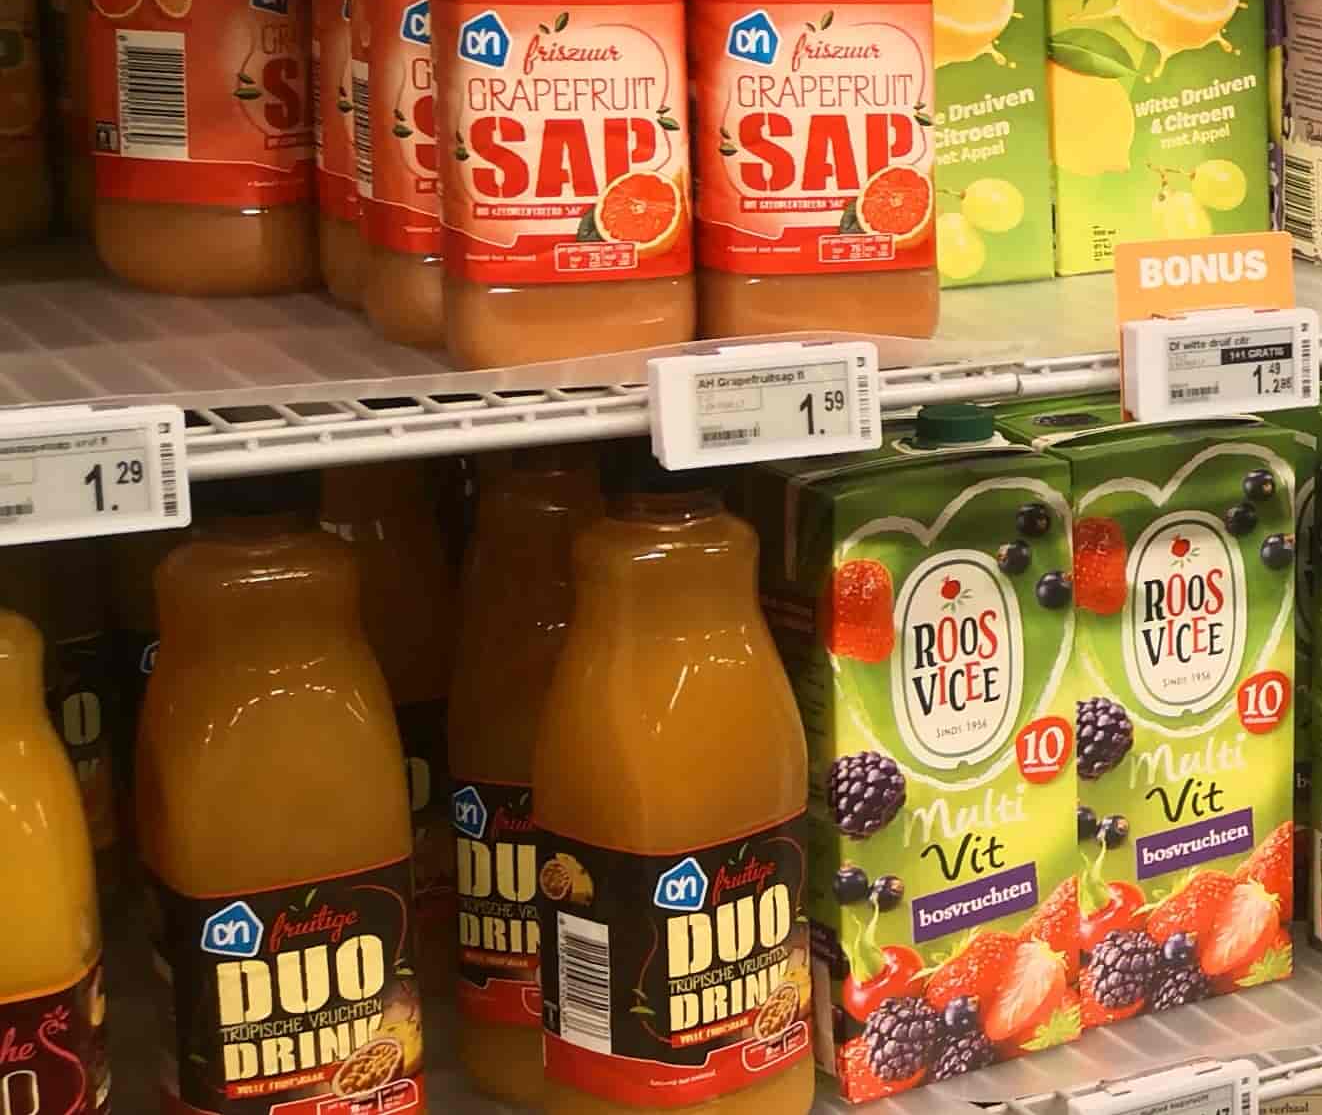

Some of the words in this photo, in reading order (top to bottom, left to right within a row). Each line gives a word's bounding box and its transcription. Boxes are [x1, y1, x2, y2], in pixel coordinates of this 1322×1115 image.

[523, 33, 626, 75] friszuur
[792, 32, 882, 72] friszuur
[468, 77, 656, 113] GRAPEFRUIT
[737, 74, 914, 110] GRAPEFRUIT
[948, 86, 1035, 123] Druiven
[1135, 93, 1179, 119] Witte
[1181, 72, 1257, 107] Druiven
[1163, 103, 1236, 133] Citroen
[469, 116, 657, 199] SAP
[738, 112, 914, 193] SAP
[1139, 250, 1268, 289] BONUS
[1247, 347, 1287, 360] GRATIS
[697, 377, 716, 390] AH
[717, 371, 794, 388] Grapefruitsap
[1143, 568, 1224, 625] ROOS
[913, 609, 999, 671] ROOS
[1141, 616, 1224, 667] VICEE
[912, 662, 1000, 716] VICEE
[1243, 678, 1285, 717] 10
[1023, 725, 1066, 766] 10
[1129, 731, 1247, 789] Multi
[905, 782, 1027, 848] Multi
[1145, 778, 1225, 825] Vit
[921, 831, 1005, 881] Vit
[1142, 822, 1249, 867] bosvruchten
[918, 879, 1032, 929] bosvruchten
[270, 905, 361, 953] fruitige
[666, 883, 791, 979] DUO
[216, 934, 385, 1026] DUO
[668, 964, 735, 995] TROPISCHE
[669, 959, 791, 1033] DRINK
[221, 1016, 303, 1042] TROPISCHE
[308, 999, 383, 1028] VRUCHTEN
[223, 1013, 383, 1082] DRINK
